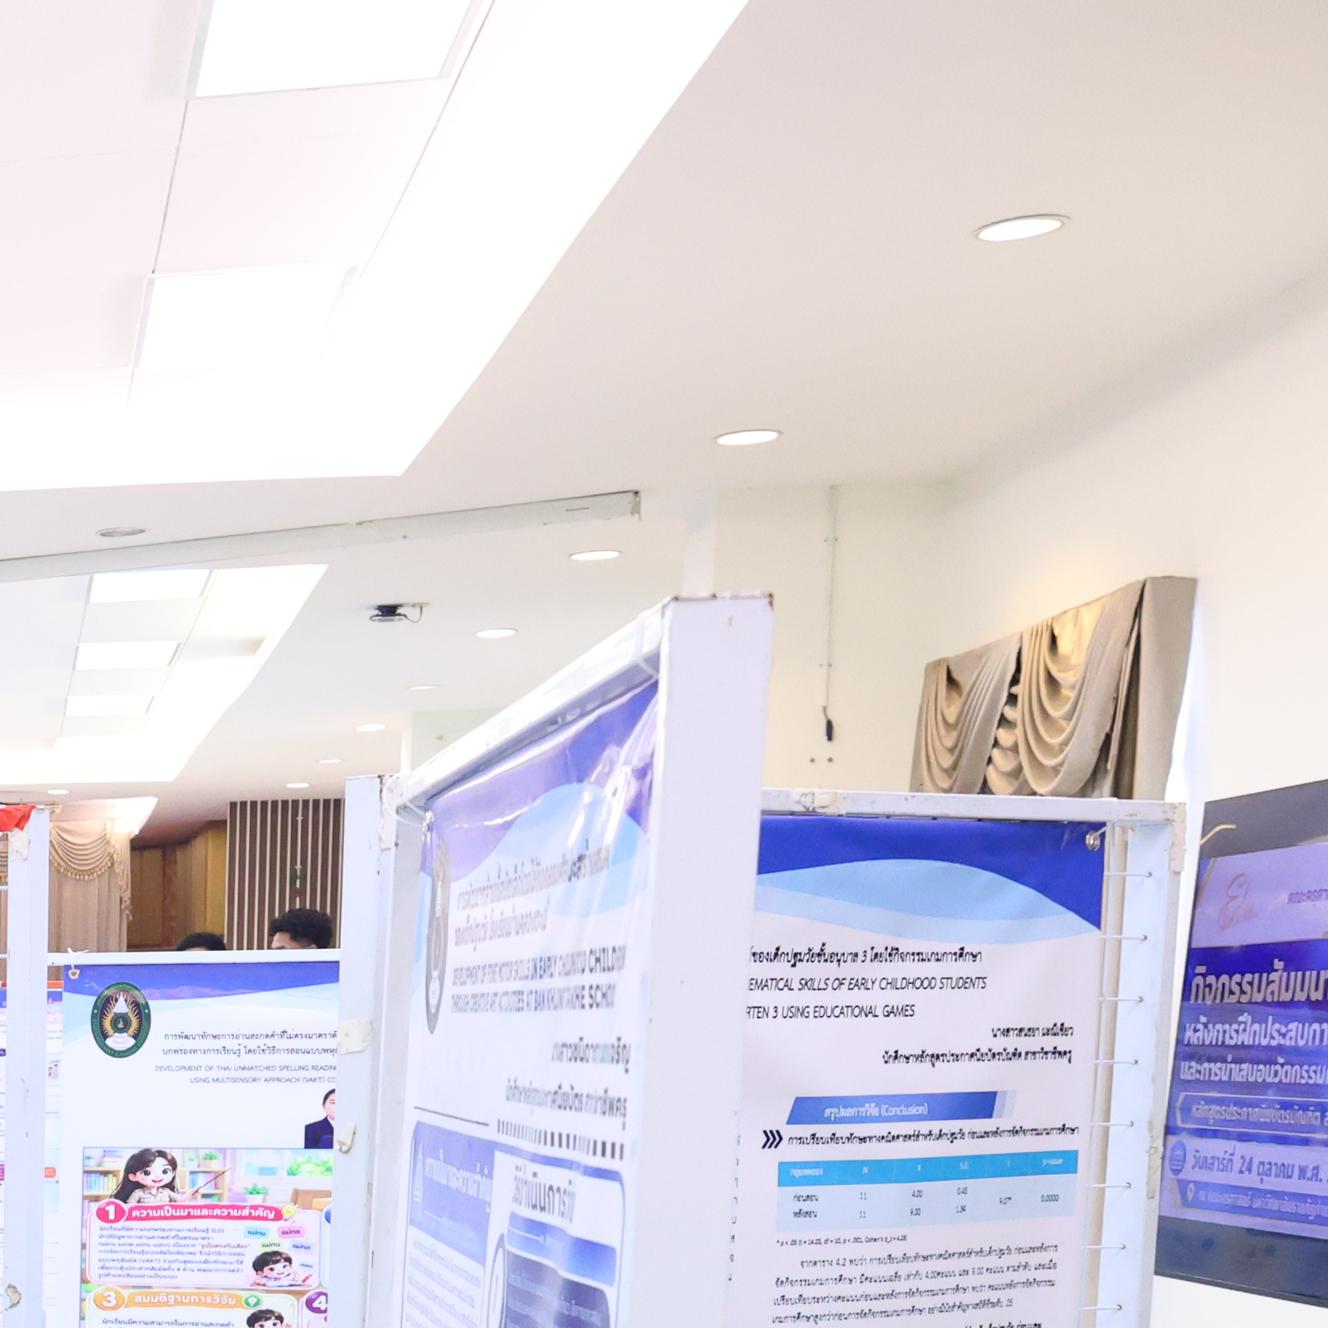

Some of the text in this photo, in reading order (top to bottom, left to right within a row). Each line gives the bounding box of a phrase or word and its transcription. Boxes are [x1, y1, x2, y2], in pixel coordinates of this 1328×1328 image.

[750, 943, 858, 968] ของเด็กปฐมวัยชั้นอนุบาล
[861, 950, 867, 963] 3
[749, 976, 987, 992] EMATICAL SKILLS OF EARLY CHILDHOOD STUDENTS
[746, 1004, 915, 1019] RTEN 3 USING EDUCATIONAL GAMES
[1184, 1013, 1328, 1046] หลังการฝึกประสบกา
[244, 1044, 337, 1056] โดยใช้วิธีการสอนแบบพหุ
[1180, 1054, 1328, 1085] และการนำเสนอนวัตกรรม
[881, 1102, 929, 1117] (Conclusion)
[1238, 1156, 1253, 1175] 24
[1257, 1161, 1294, 1184] ตุลาคม
[1298, 1163, 1322, 1182] พ.ศ.
[105, 1204, 276, 1219] 1 ความเป็นมาและความสำคัญ
[103, 1291, 237, 1306] 3 สมมติฐานการวิจัย
